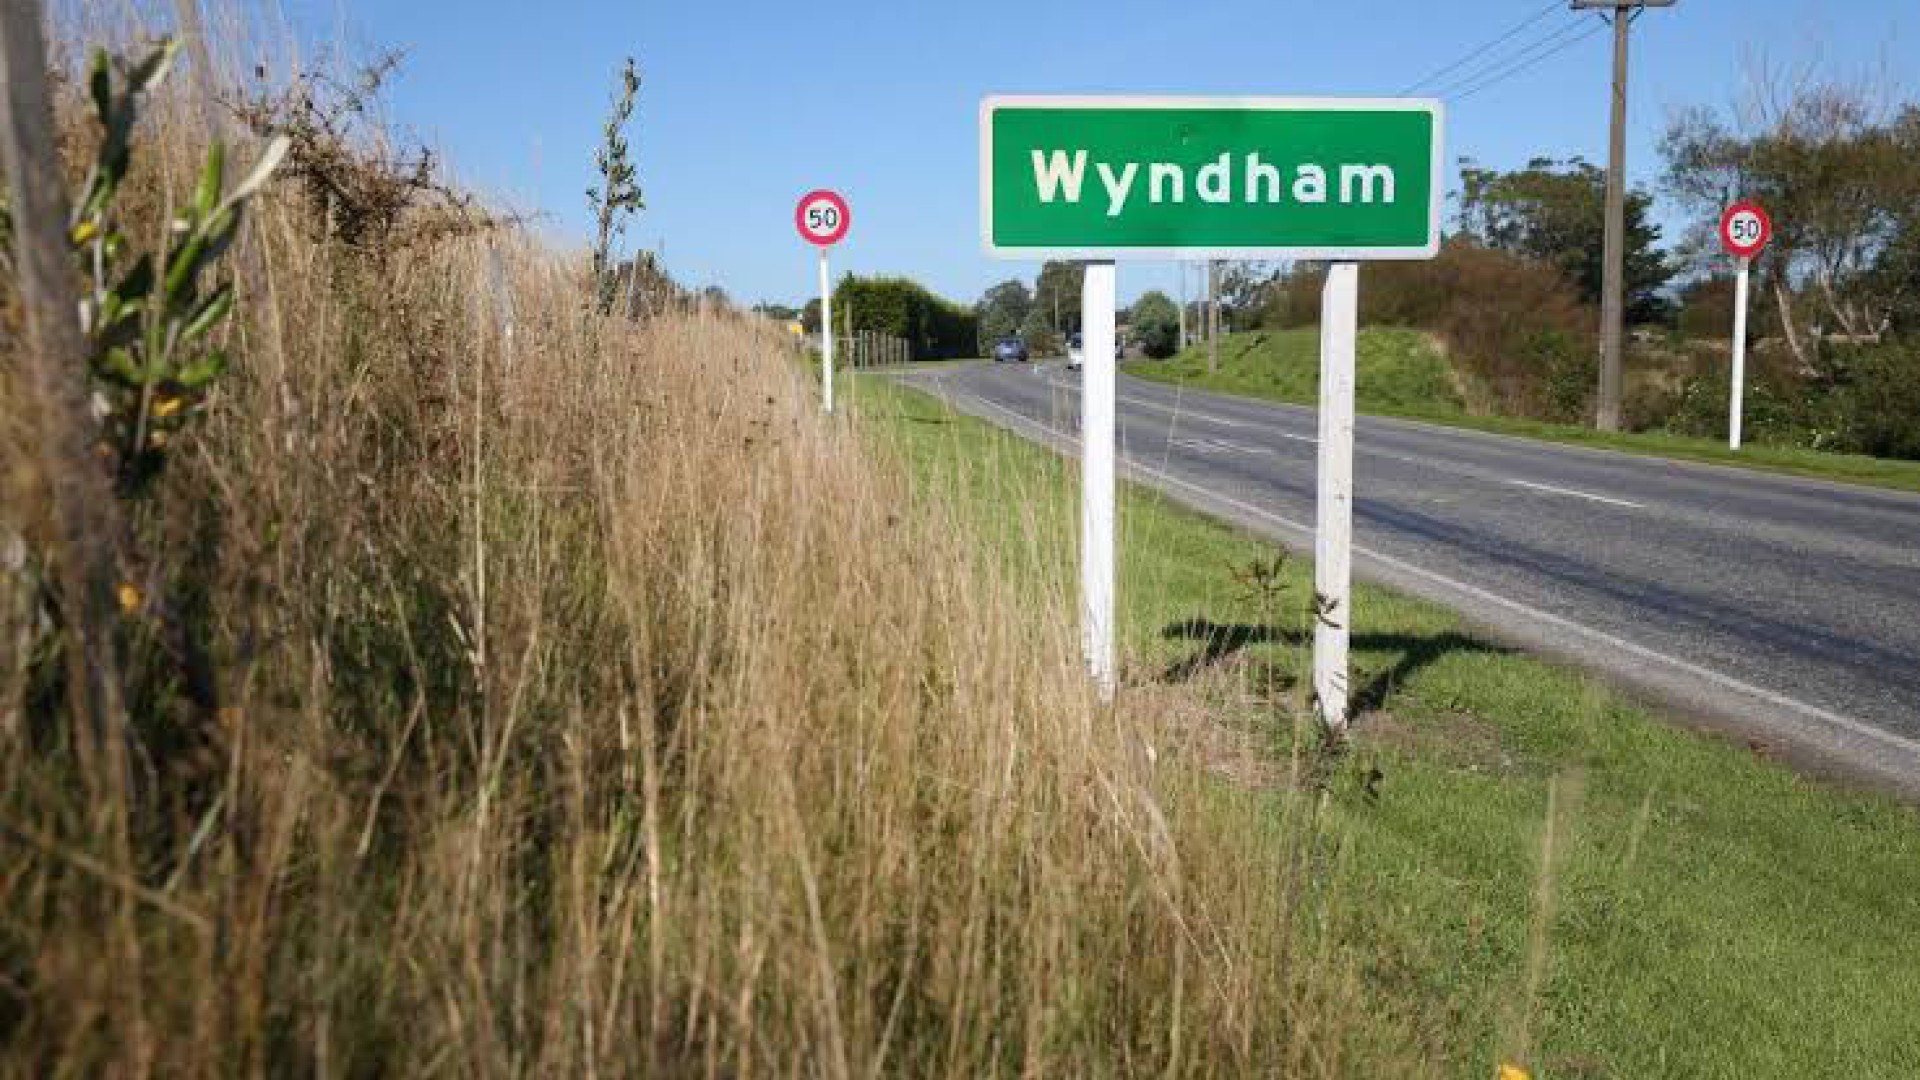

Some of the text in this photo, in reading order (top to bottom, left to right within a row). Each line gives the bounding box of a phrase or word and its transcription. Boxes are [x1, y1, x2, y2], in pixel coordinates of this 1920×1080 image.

[1031, 149, 1396, 216] Wyndham
[809, 207, 837, 229] 50
[1733, 219, 1759, 240] 50
